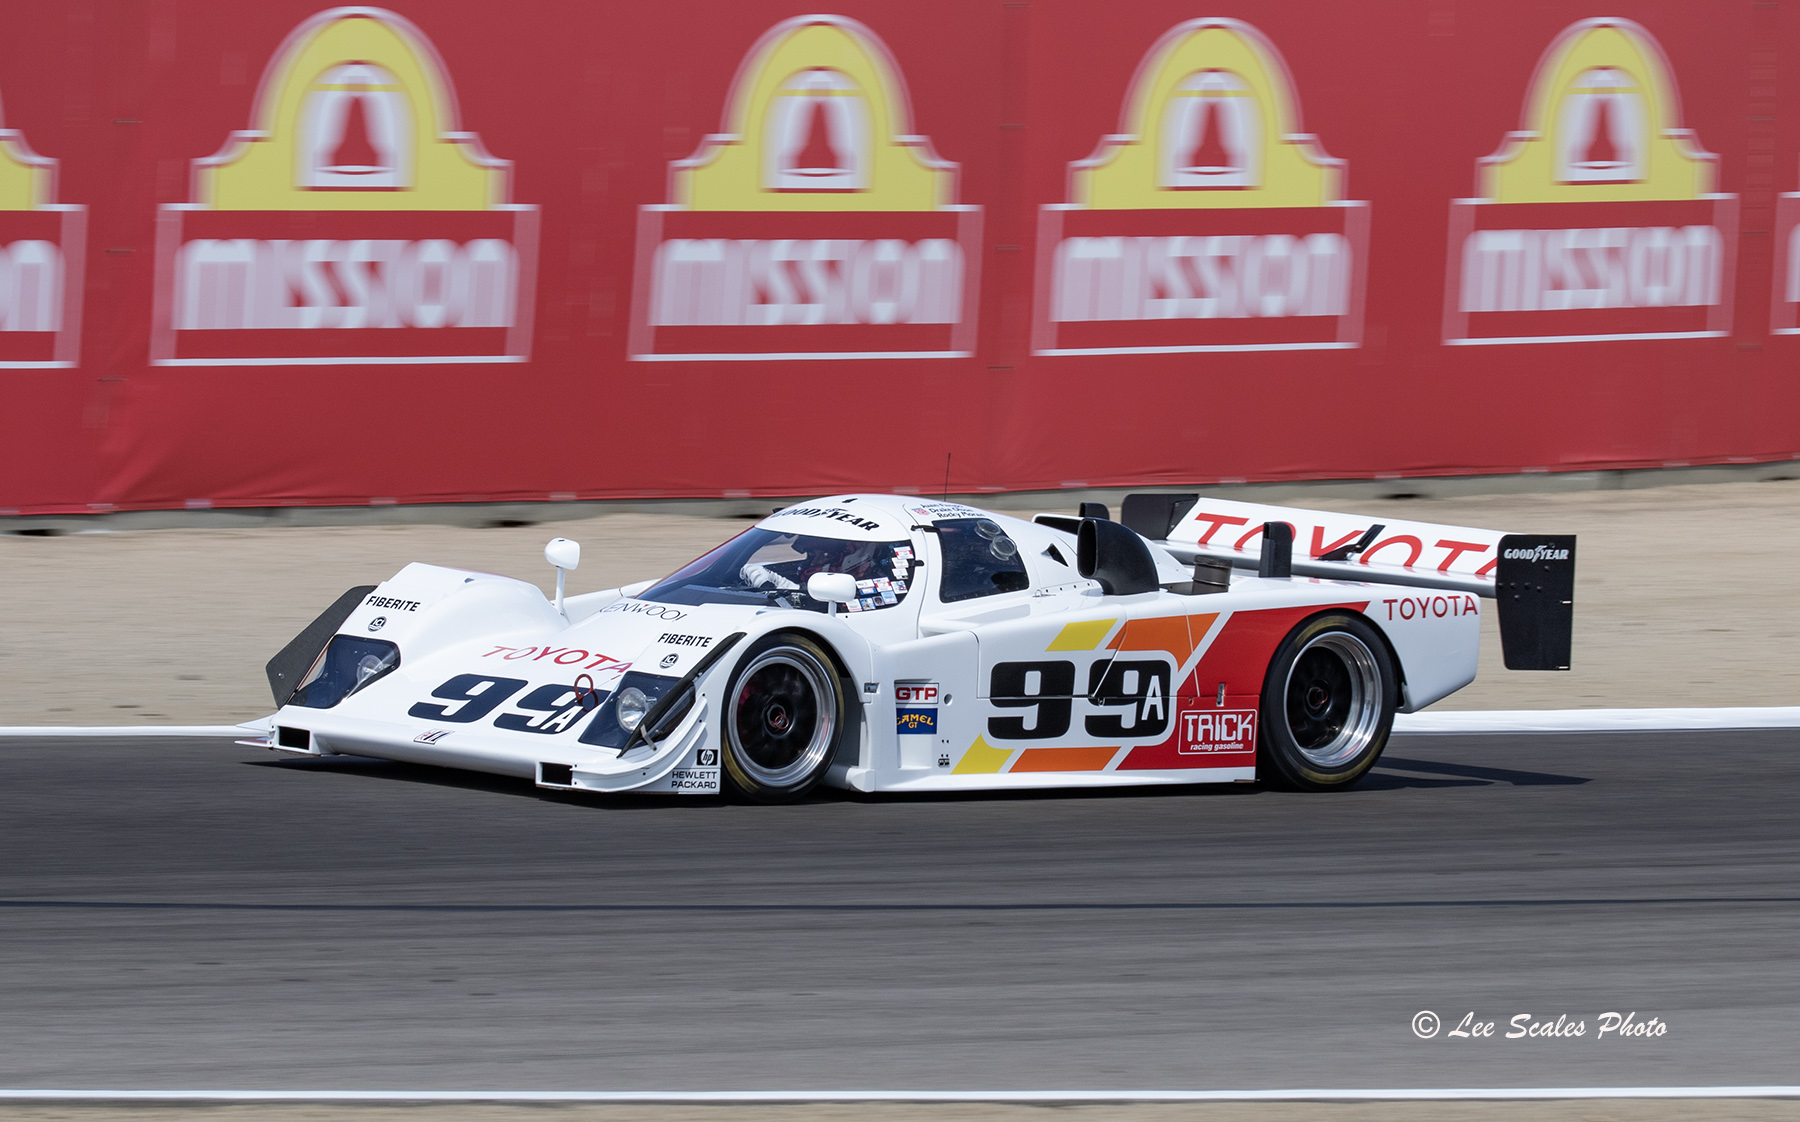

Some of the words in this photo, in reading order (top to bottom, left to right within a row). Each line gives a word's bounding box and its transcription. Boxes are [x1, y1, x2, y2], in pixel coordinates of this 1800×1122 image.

[1195, 513, 1497, 576] TYOT
[366, 596, 421, 611] FIBERITE
[1383, 595, 1478, 621] TOYOTA
[657, 633, 713, 648] FIBERITE
[482, 646, 633, 673] TOYOTA
[896, 687, 937, 701] GTP
[1184, 713, 1253, 742] TRICK
[1190, 742, 1213, 751] racing
[1214, 741, 1244, 751] gasoline
[671, 770, 717, 779] HEWLETT
[671, 780, 717, 789] PACKARD
